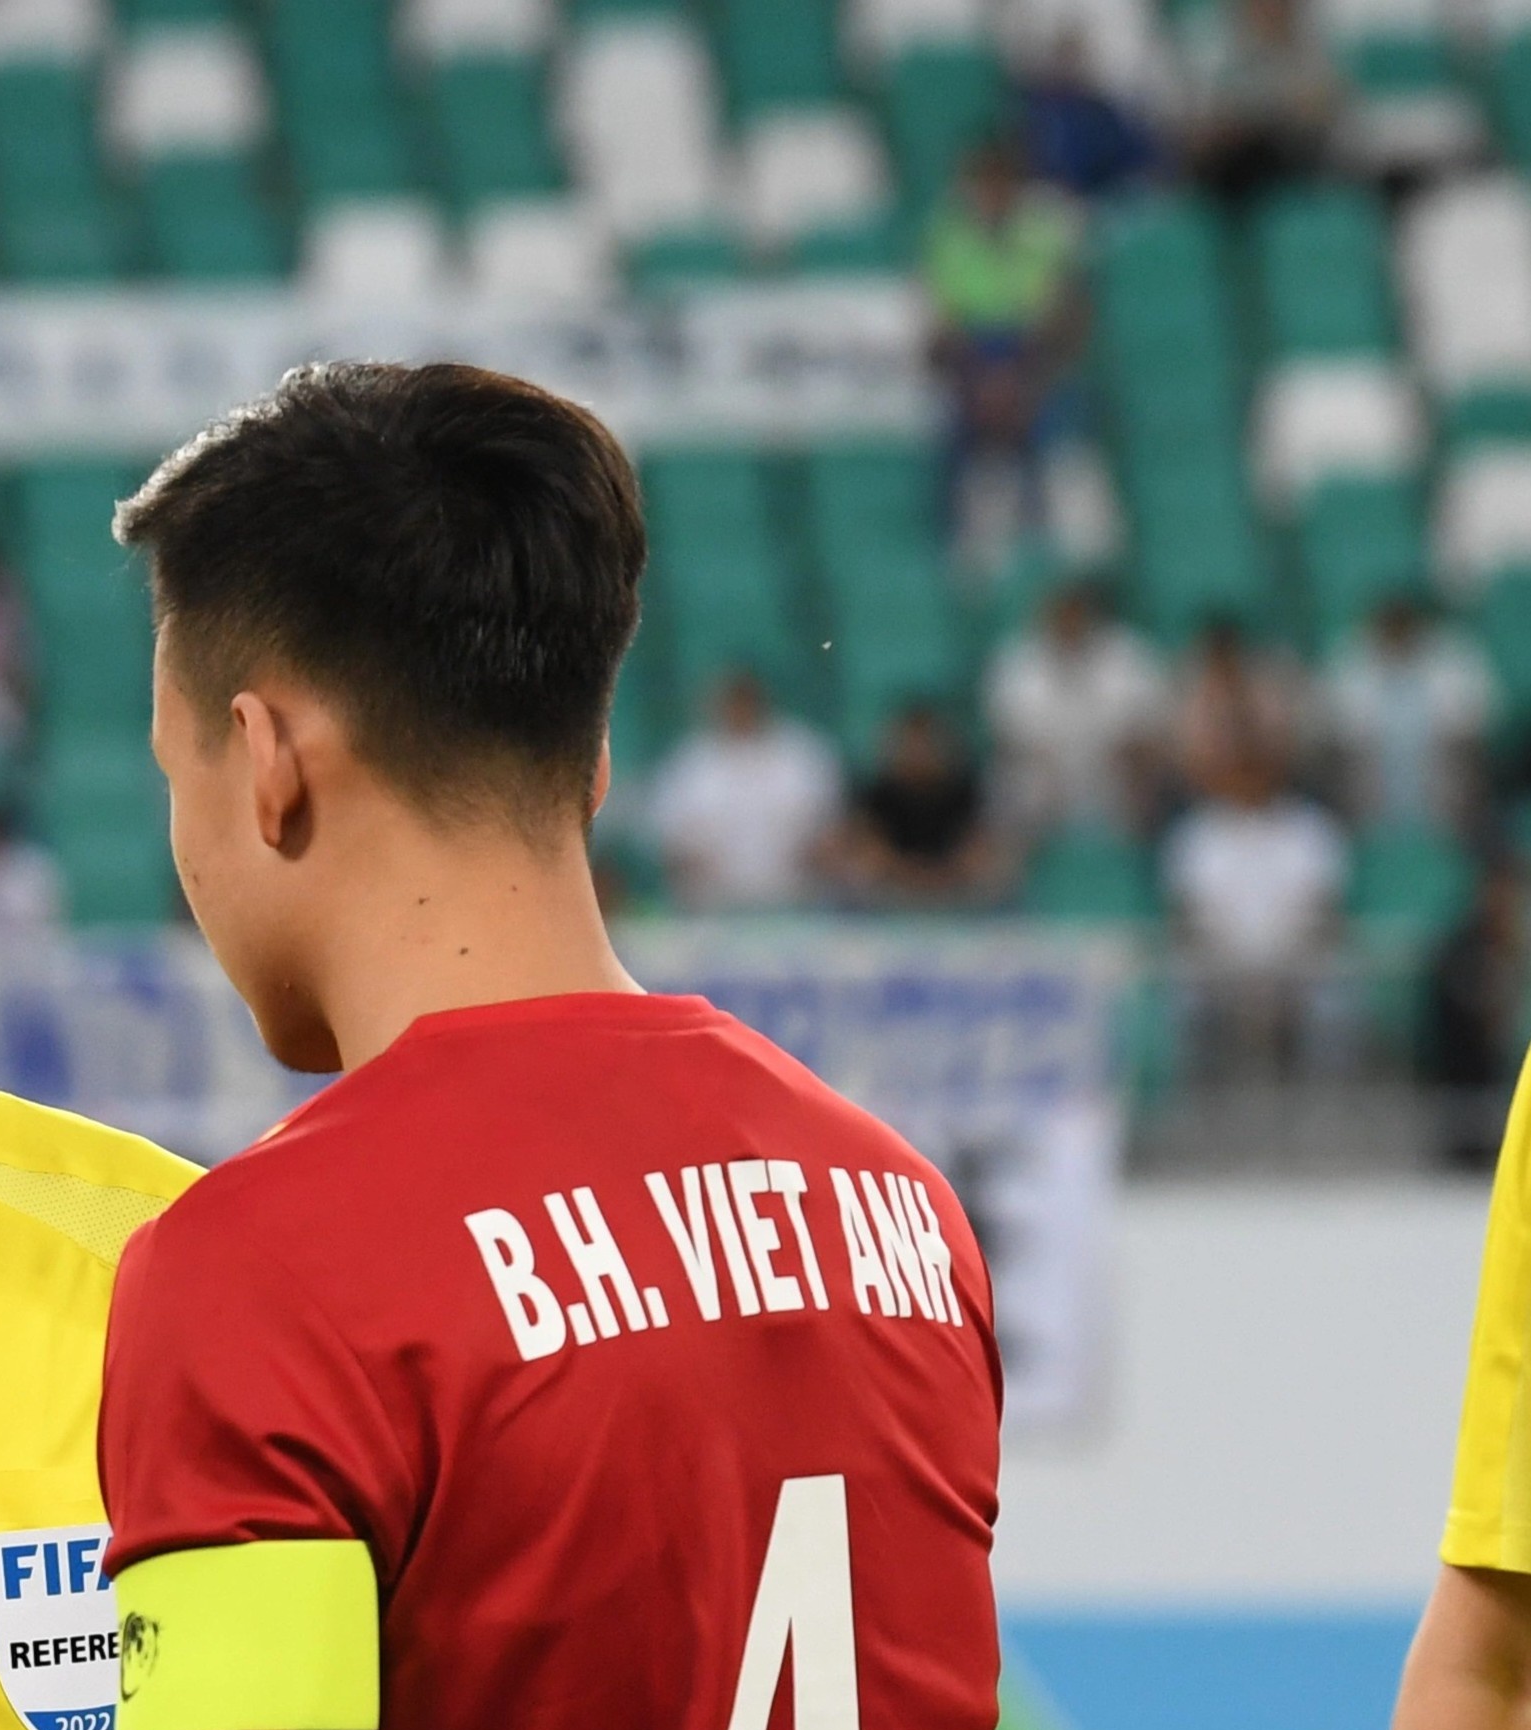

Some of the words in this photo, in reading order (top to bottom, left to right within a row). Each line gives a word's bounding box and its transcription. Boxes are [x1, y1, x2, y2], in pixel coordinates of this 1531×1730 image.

[464, 1186, 670, 1361] B.H.
[644, 1159, 830, 1322] VIET
[829, 1167, 963, 1327] ANH
[9, 1631, 120, 1670] REFERE
